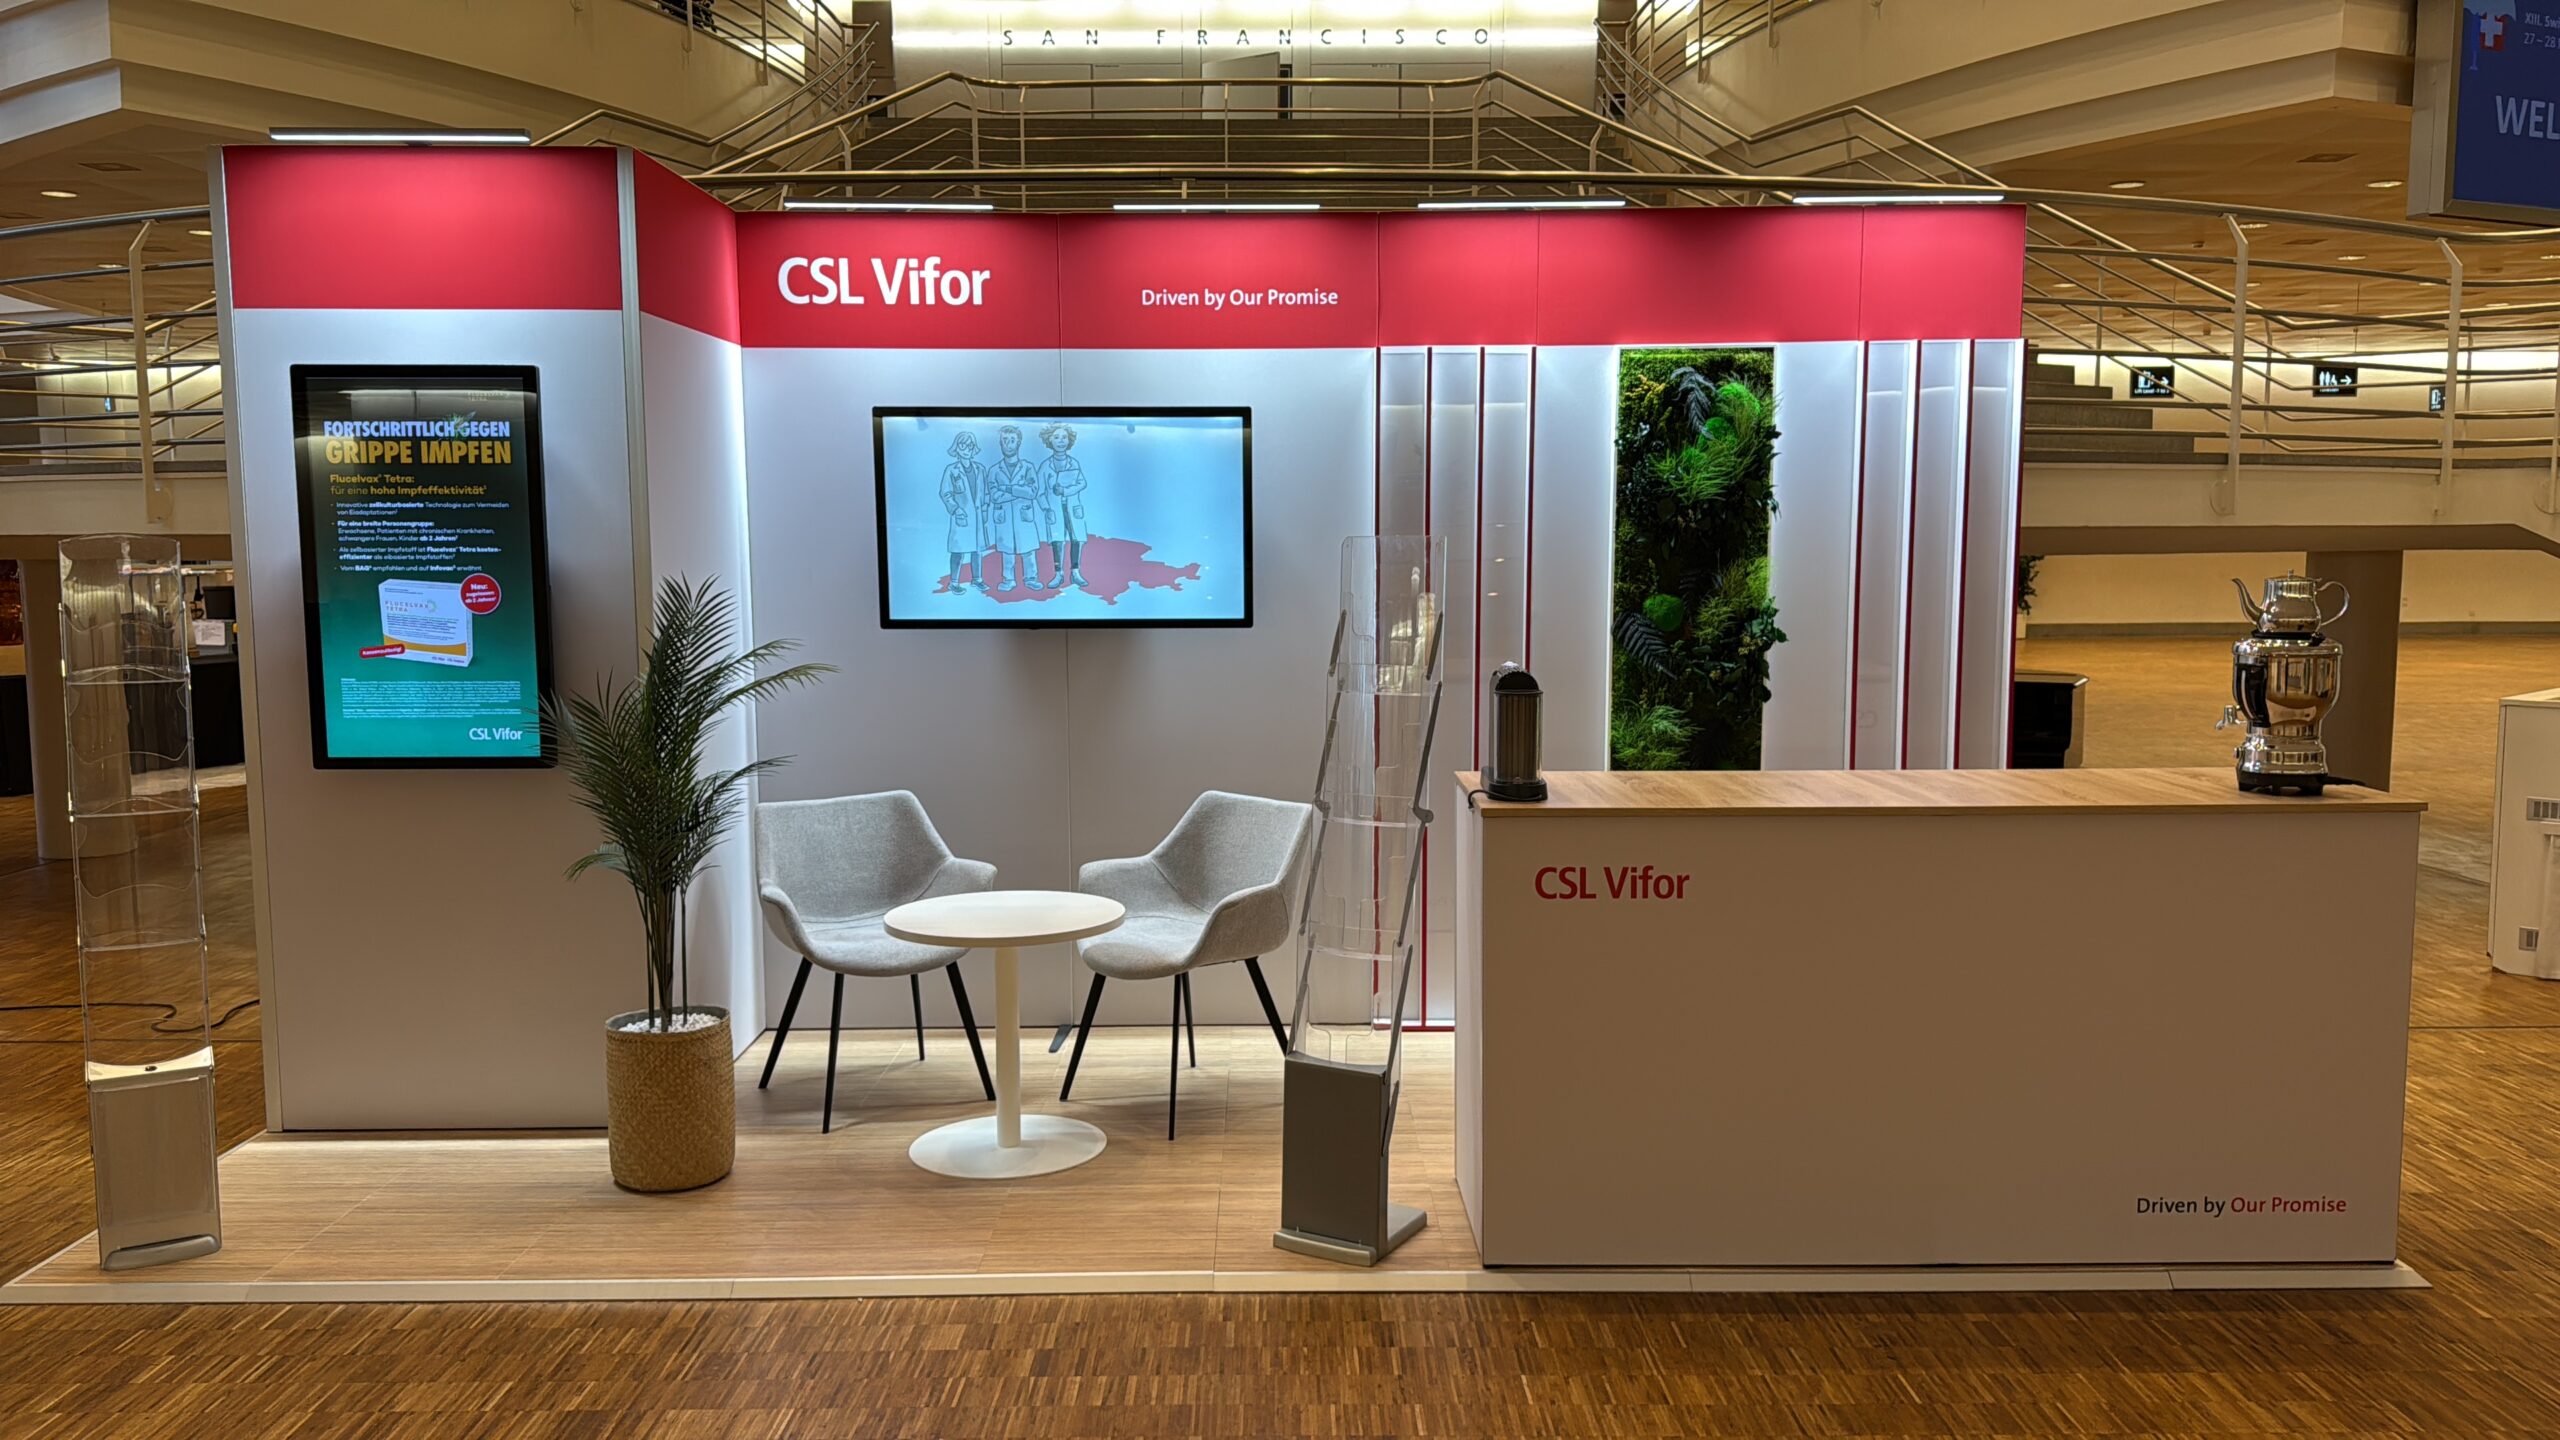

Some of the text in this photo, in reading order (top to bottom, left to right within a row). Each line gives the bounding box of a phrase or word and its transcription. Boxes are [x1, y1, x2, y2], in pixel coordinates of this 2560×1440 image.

[1003, 28, 1489, 46] SAN FRANCISCO
[2523, 32, 2536, 45] 27
[2544, 35, 2556, 49] 28
[777, 256, 991, 306] CSL Vifor
[1141, 288, 1339, 311] Driven by Our Promise
[323, 421, 510, 438] FORTSCHRITTLICH GEGEN
[325, 440, 512, 464] GRIPPE IMPFEN
[384, 475, 415, 484] Tetra:
[330, 485, 346, 495] für
[370, 485, 396, 495] hohe
[469, 727, 523, 740] CSL Vifor
[1535, 865, 1690, 899] CSL Vifor
[2137, 1196, 2347, 1218] Driven by Our Promise
